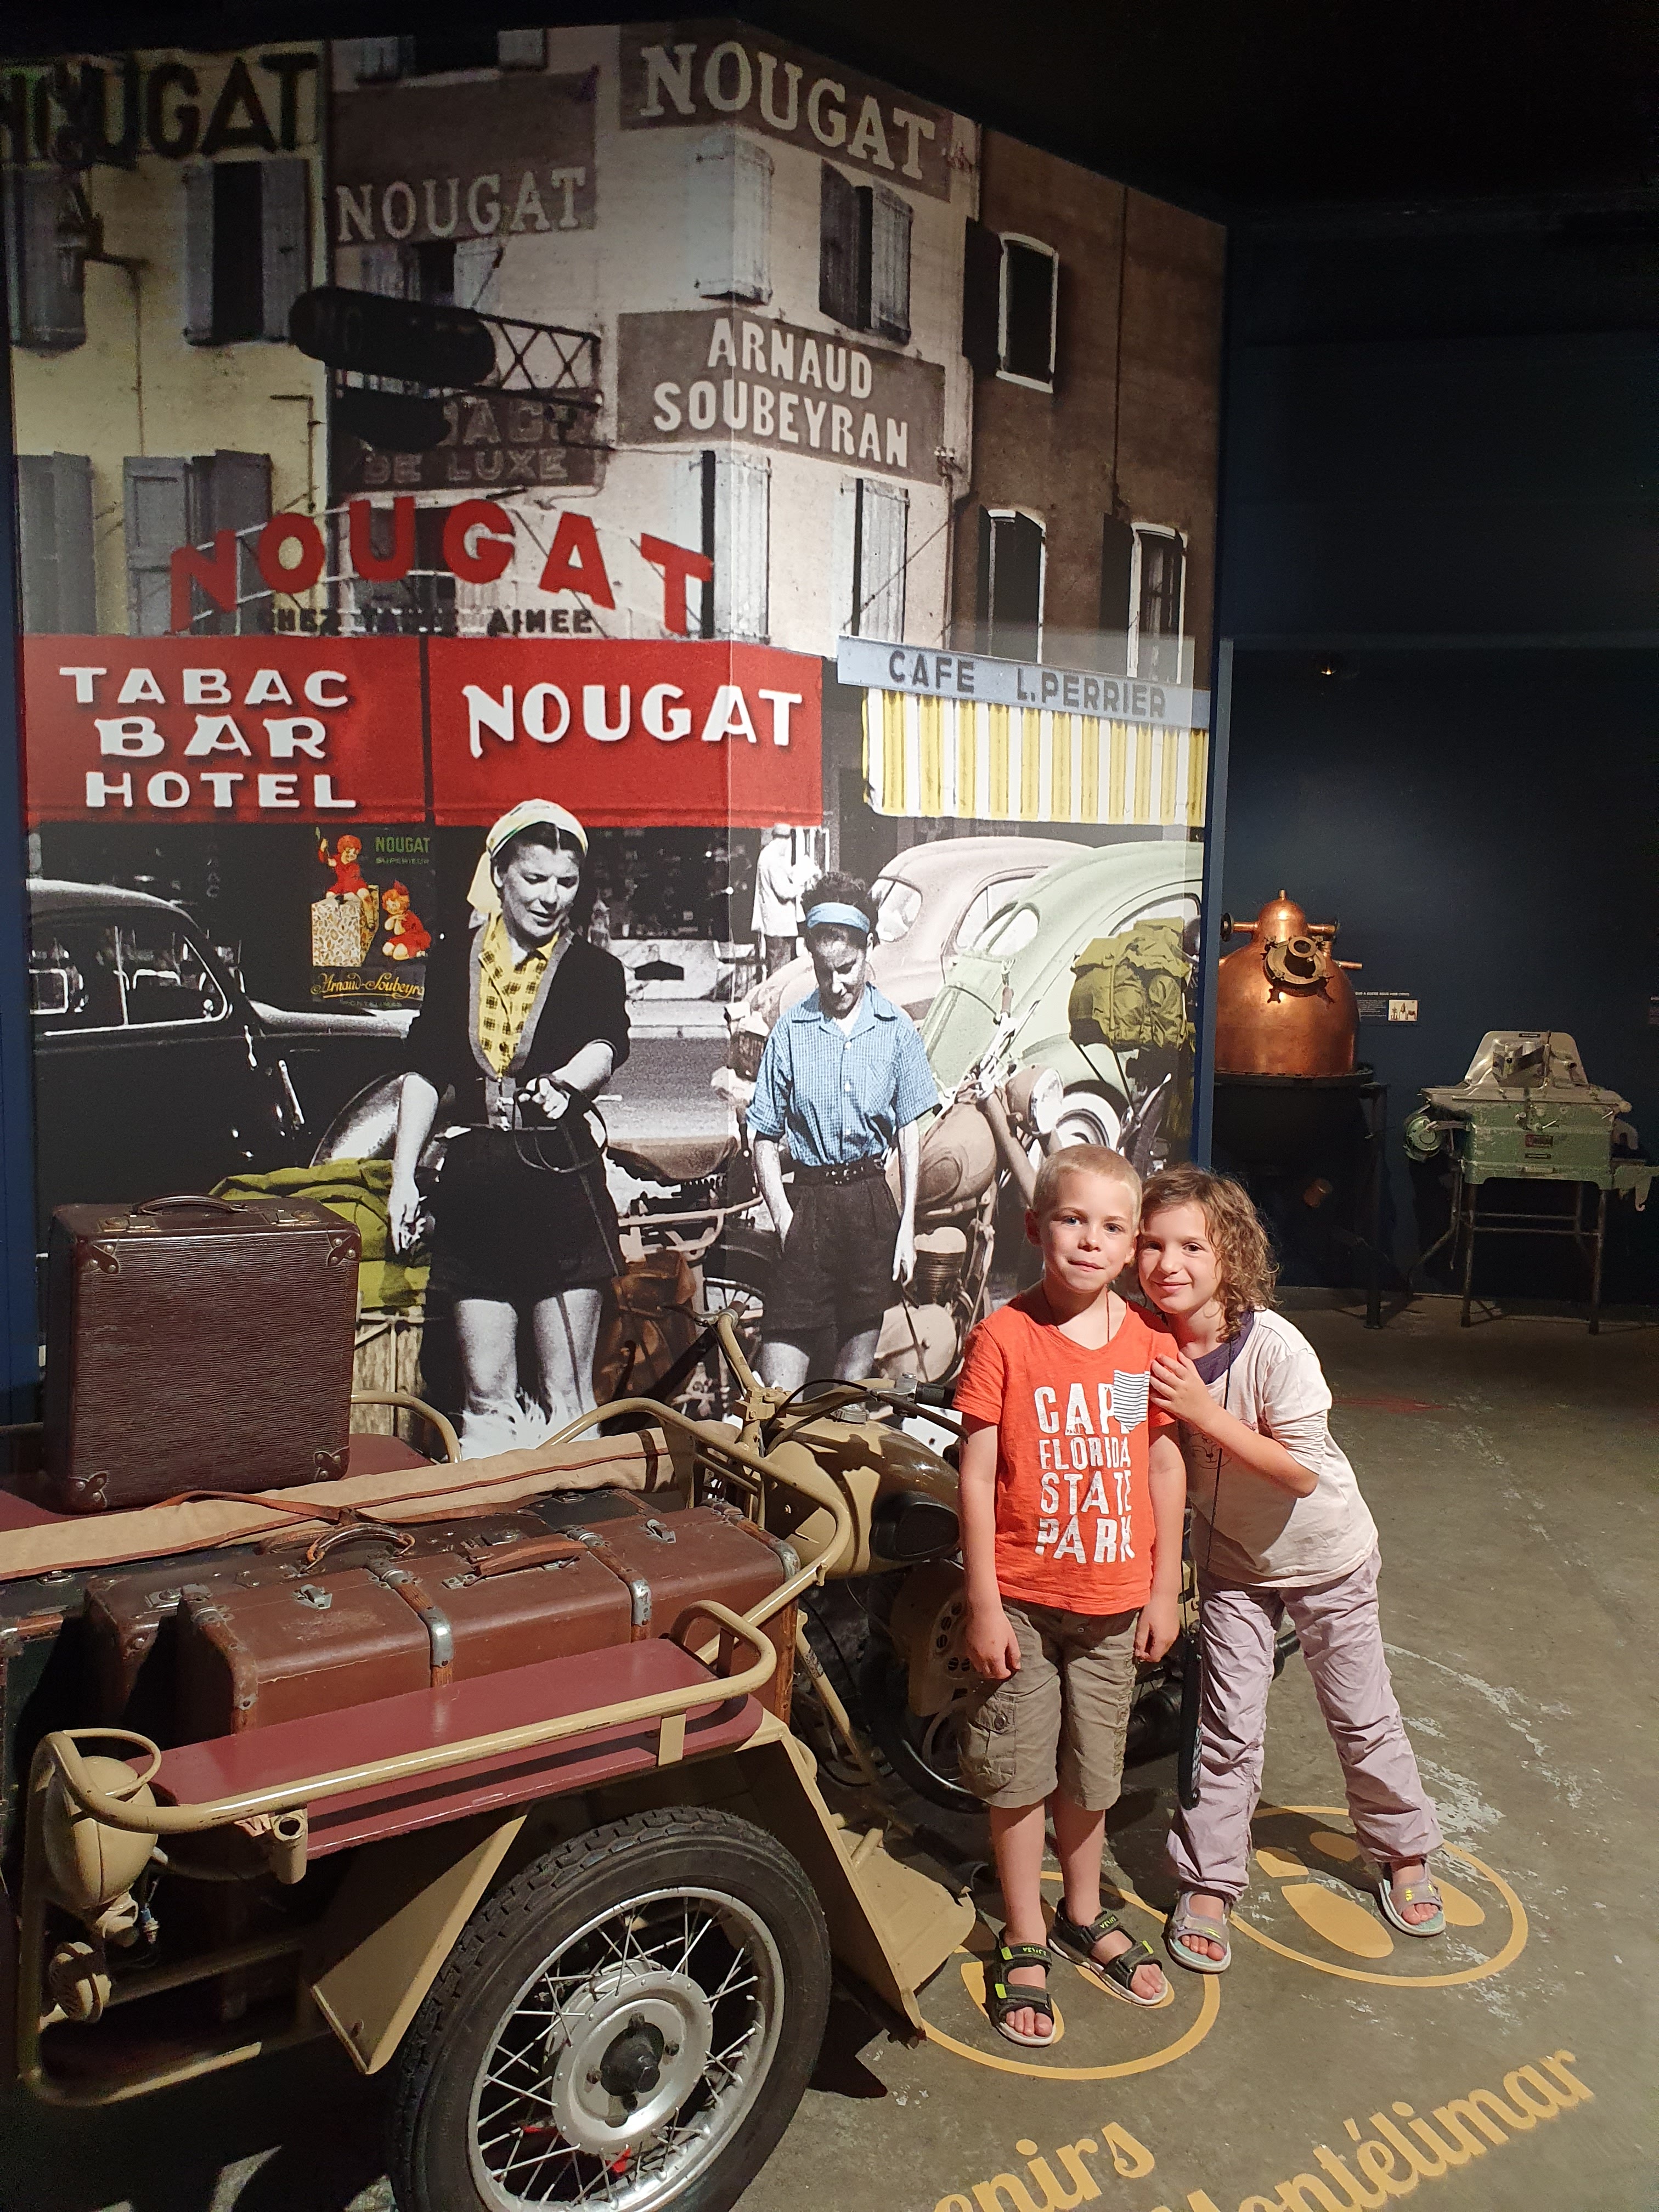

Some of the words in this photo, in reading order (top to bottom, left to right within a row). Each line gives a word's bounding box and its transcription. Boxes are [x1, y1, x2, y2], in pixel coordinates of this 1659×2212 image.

[0, 52, 319, 169] UGAT
[639, 41, 935, 180] NOUGAT
[335, 167, 586, 242] NOUGAT
[708, 317, 872, 399] ARNAUD
[653, 379, 909, 467] SOUBEYRAN
[364, 453, 422, 483] DE
[446, 447, 568, 482] LUXE
[171, 495, 713, 636] NOUGAT
[59, 667, 348, 707] TABAC
[889, 650, 975, 694] CAFE
[1017, 668, 1166, 718] L.PERRIER
[94, 714, 326, 758] BAR
[462, 682, 802, 759] NOUGAT
[86, 771, 357, 808] HOTEL
[375, 837, 430, 853] NOUGAT
[1034, 1383, 1130, 1436] CAP
[1039, 1436, 1131, 1470] FLORIDA
[1040, 1470, 1131, 1516] STATE
[1035, 1514, 1135, 1564] PARK
